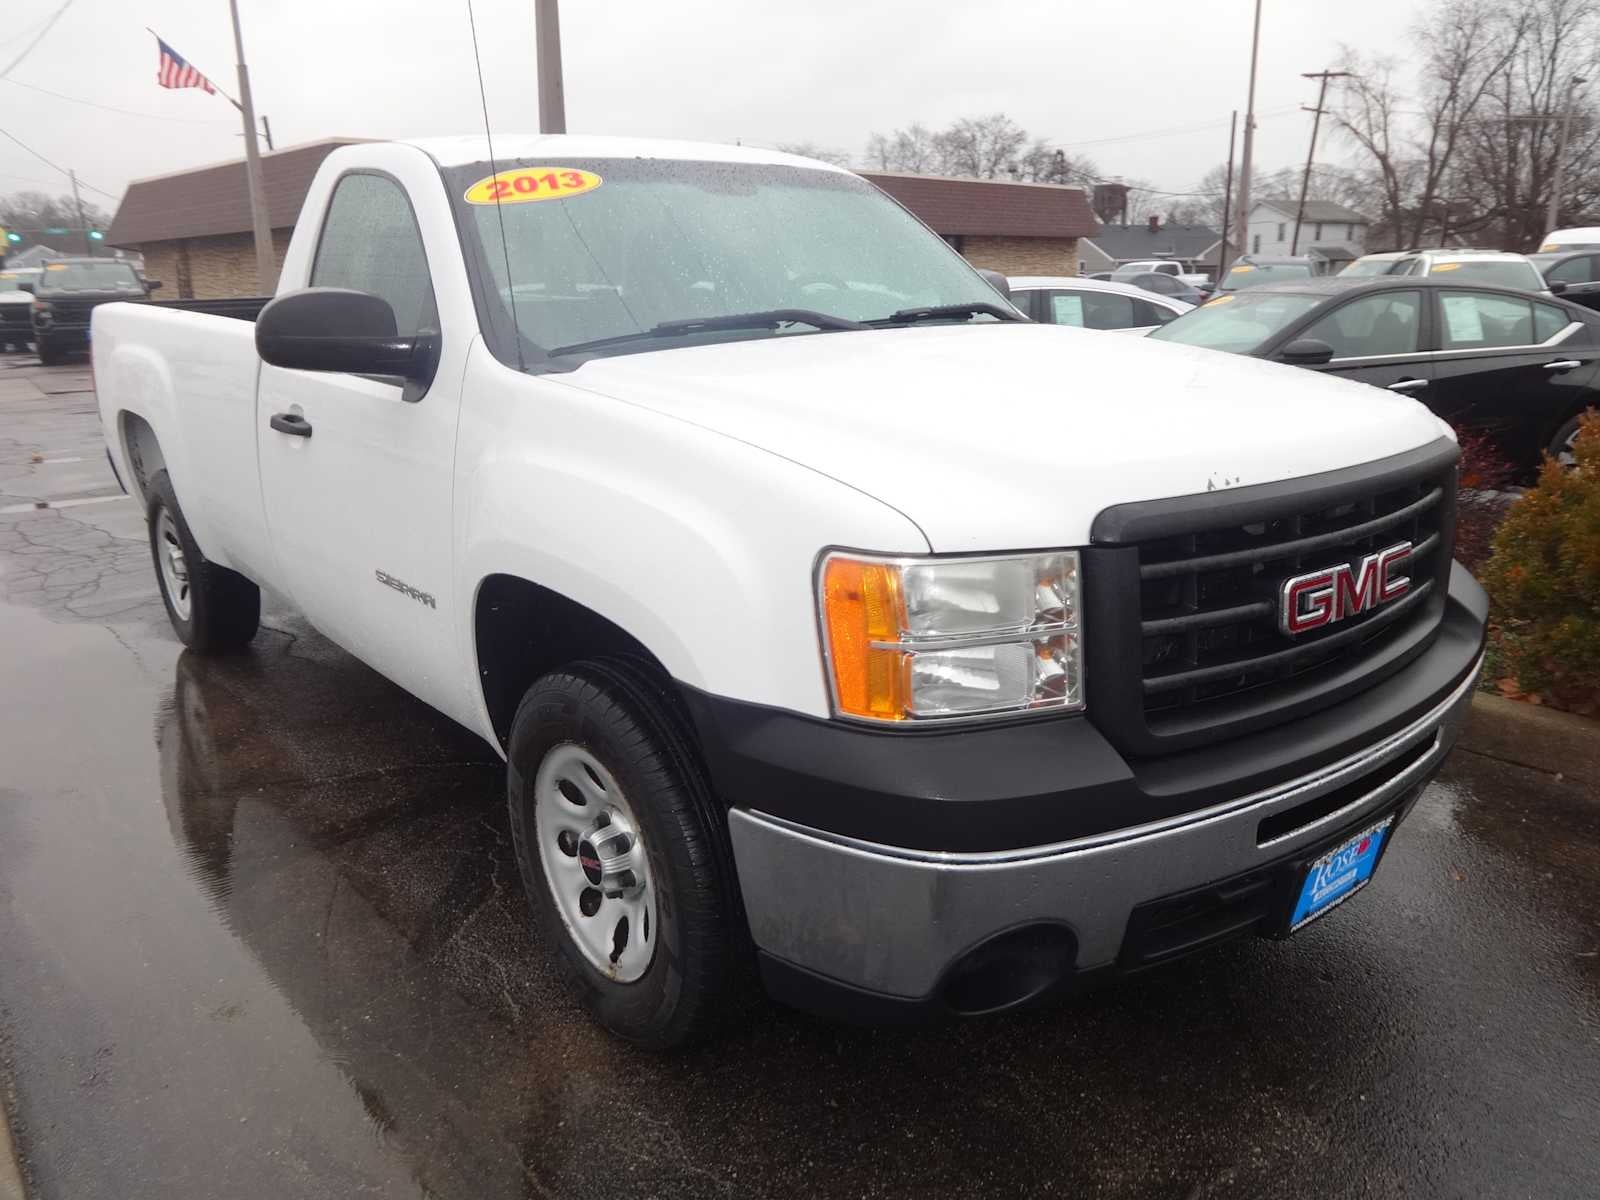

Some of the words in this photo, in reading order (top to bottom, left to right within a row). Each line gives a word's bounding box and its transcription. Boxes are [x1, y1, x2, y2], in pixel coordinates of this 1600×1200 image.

[486, 172, 586, 201] 2013
[375, 569, 437, 609] SIERRA
[1279, 541, 1413, 635] GMC
